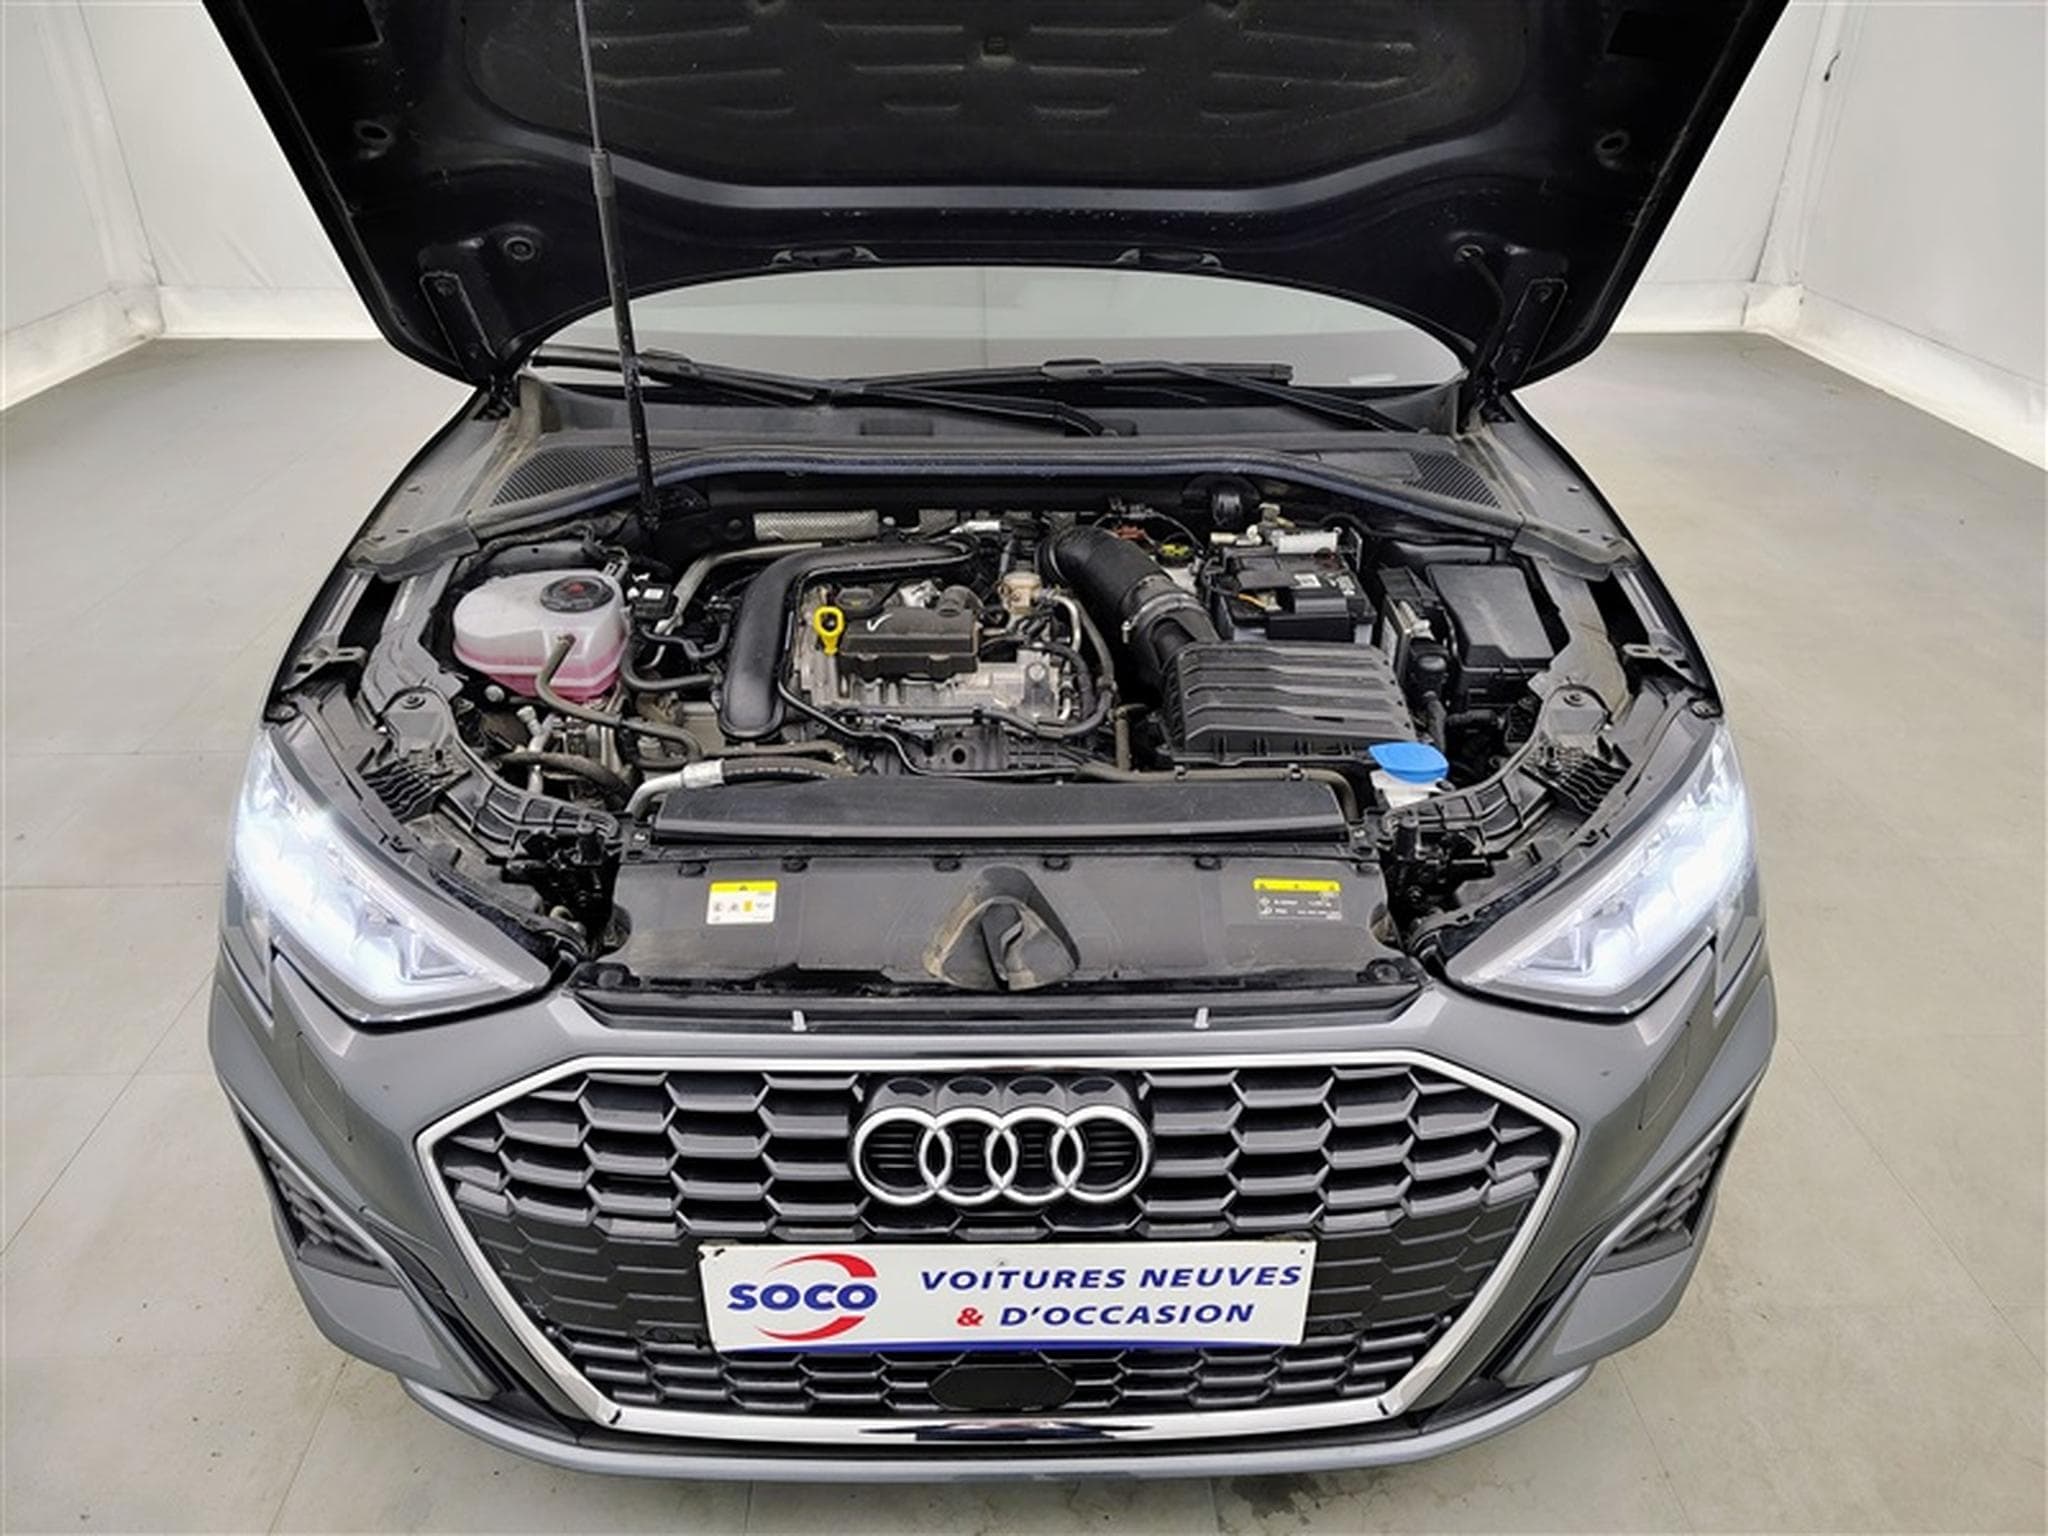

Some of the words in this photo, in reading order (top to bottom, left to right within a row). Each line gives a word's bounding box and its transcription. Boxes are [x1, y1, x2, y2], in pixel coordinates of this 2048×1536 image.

[921, 1269, 1125, 1291] VOITURES
[1139, 1266, 1301, 1289] NEUVES
[727, 1283, 878, 1312] SOCO
[956, 1307, 983, 1328] &
[1000, 1303, 1254, 1327] D'OCCASION
